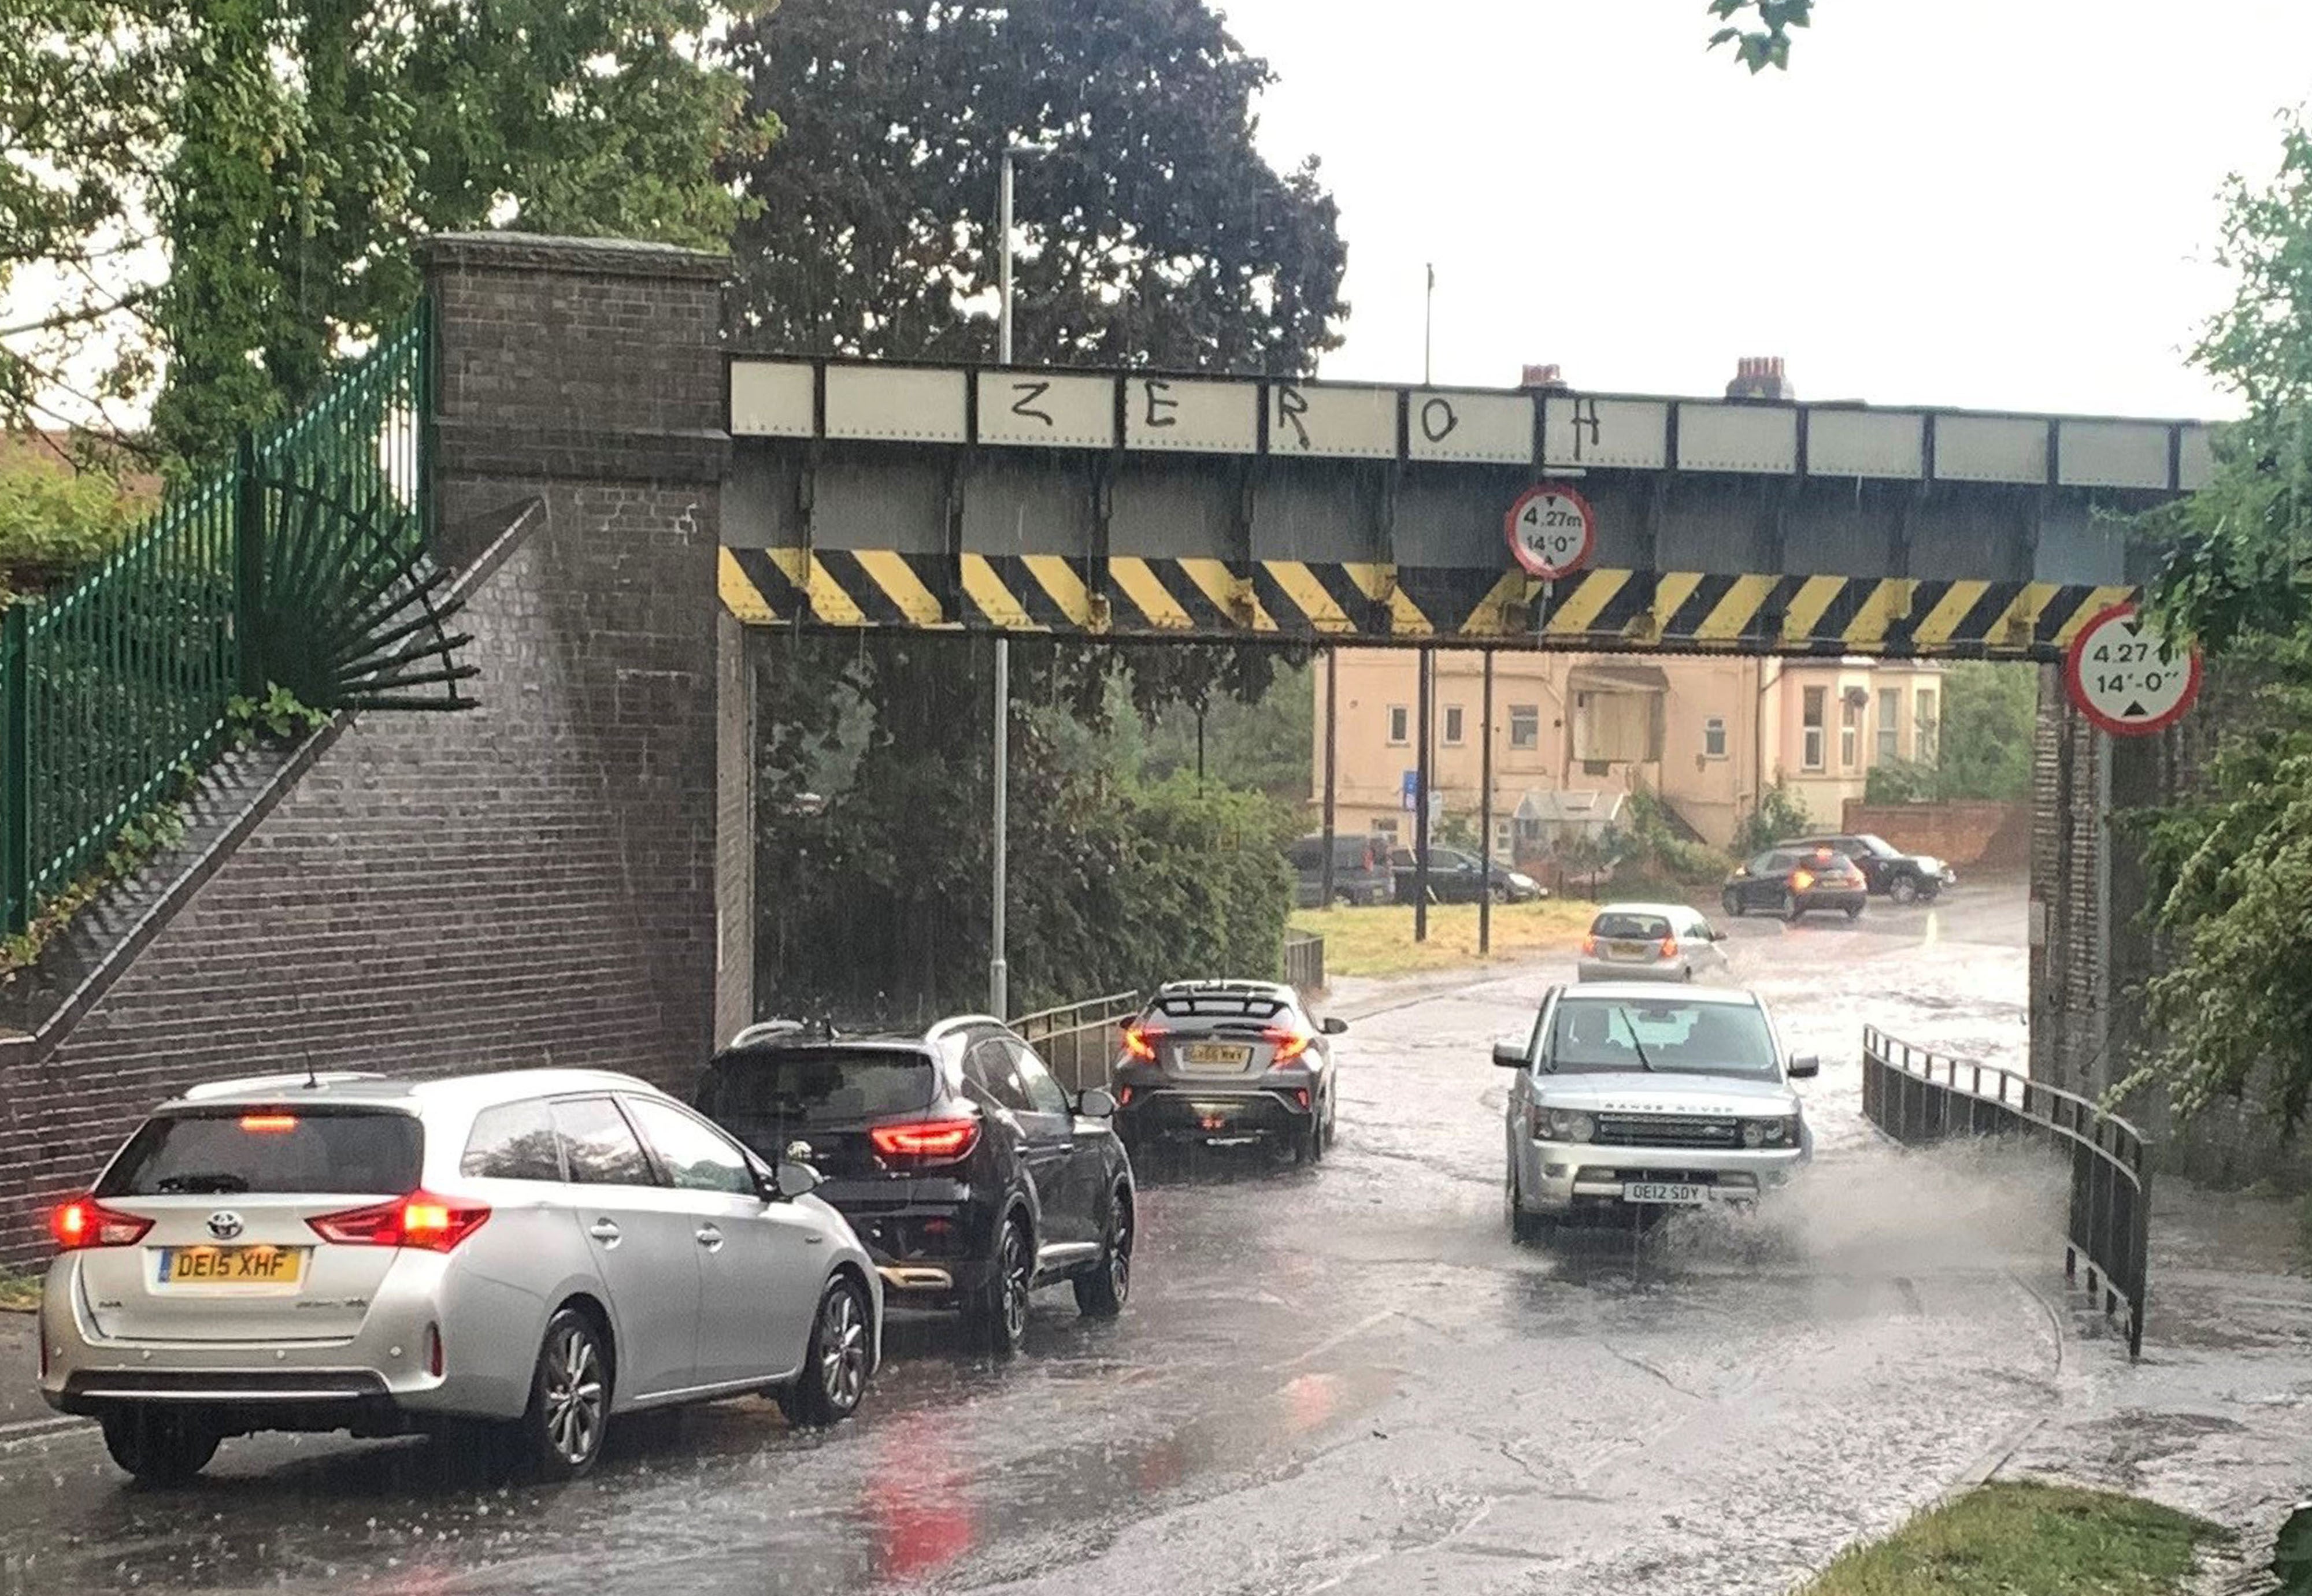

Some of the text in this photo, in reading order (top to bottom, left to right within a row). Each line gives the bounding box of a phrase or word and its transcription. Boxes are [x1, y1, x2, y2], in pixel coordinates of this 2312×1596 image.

[1523, 506, 1583, 527] 4.27m
[177, 1252, 288, 1278] DE15 XHF
